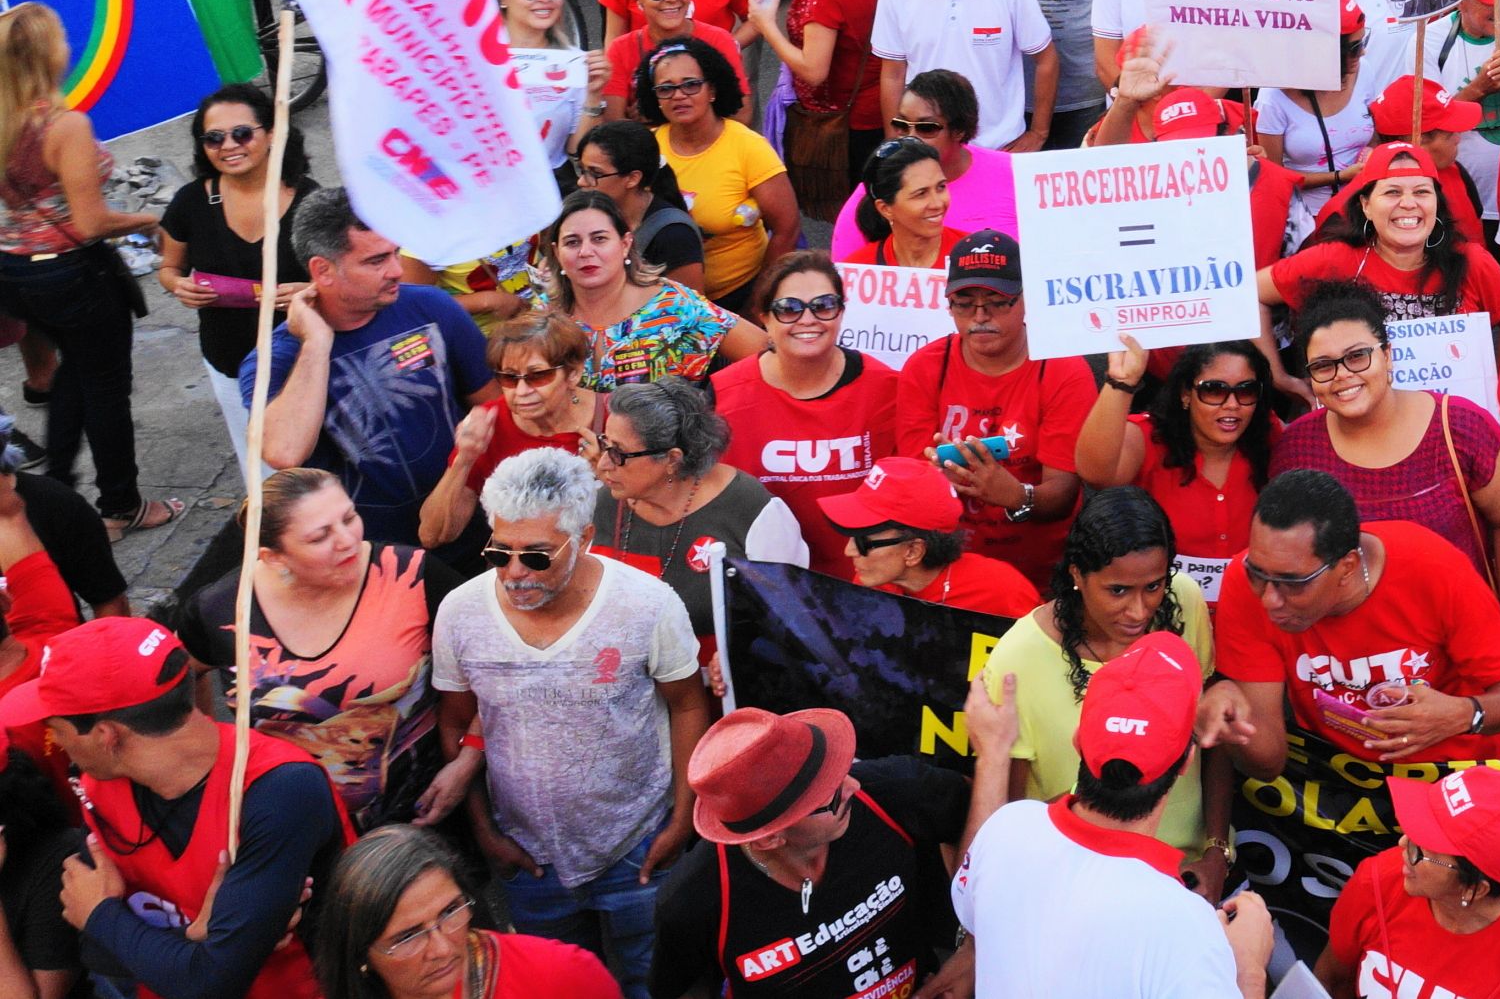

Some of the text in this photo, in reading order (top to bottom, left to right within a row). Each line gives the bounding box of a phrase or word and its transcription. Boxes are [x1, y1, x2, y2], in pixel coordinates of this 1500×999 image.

[1170, 6, 1312, 31] MINHA VIDA
[1160, 101, 1196, 123] CUT
[1035, 148, 1229, 209] TERCEIRIZAÇÃO
[959, 252, 1006, 267] HOLLISTER
[1045, 257, 1243, 307] ESCRAVIDÃO
[1117, 302, 1210, 324] SINPROJA
[840, 324, 928, 353] enhum
[1387, 320, 1466, 340] SSIONAIS
[1392, 347, 1416, 362] DA
[761, 431, 872, 473] CUT BRASIL
[760, 475, 787, 483] CENTRAL
[1188, 562, 1227, 574] panel
[138, 628, 167, 657] CUT
[1296, 648, 1407, 690] CUT
[1105, 717, 1149, 736] CUT
[835, 884, 905, 943] Articulação Sindical
